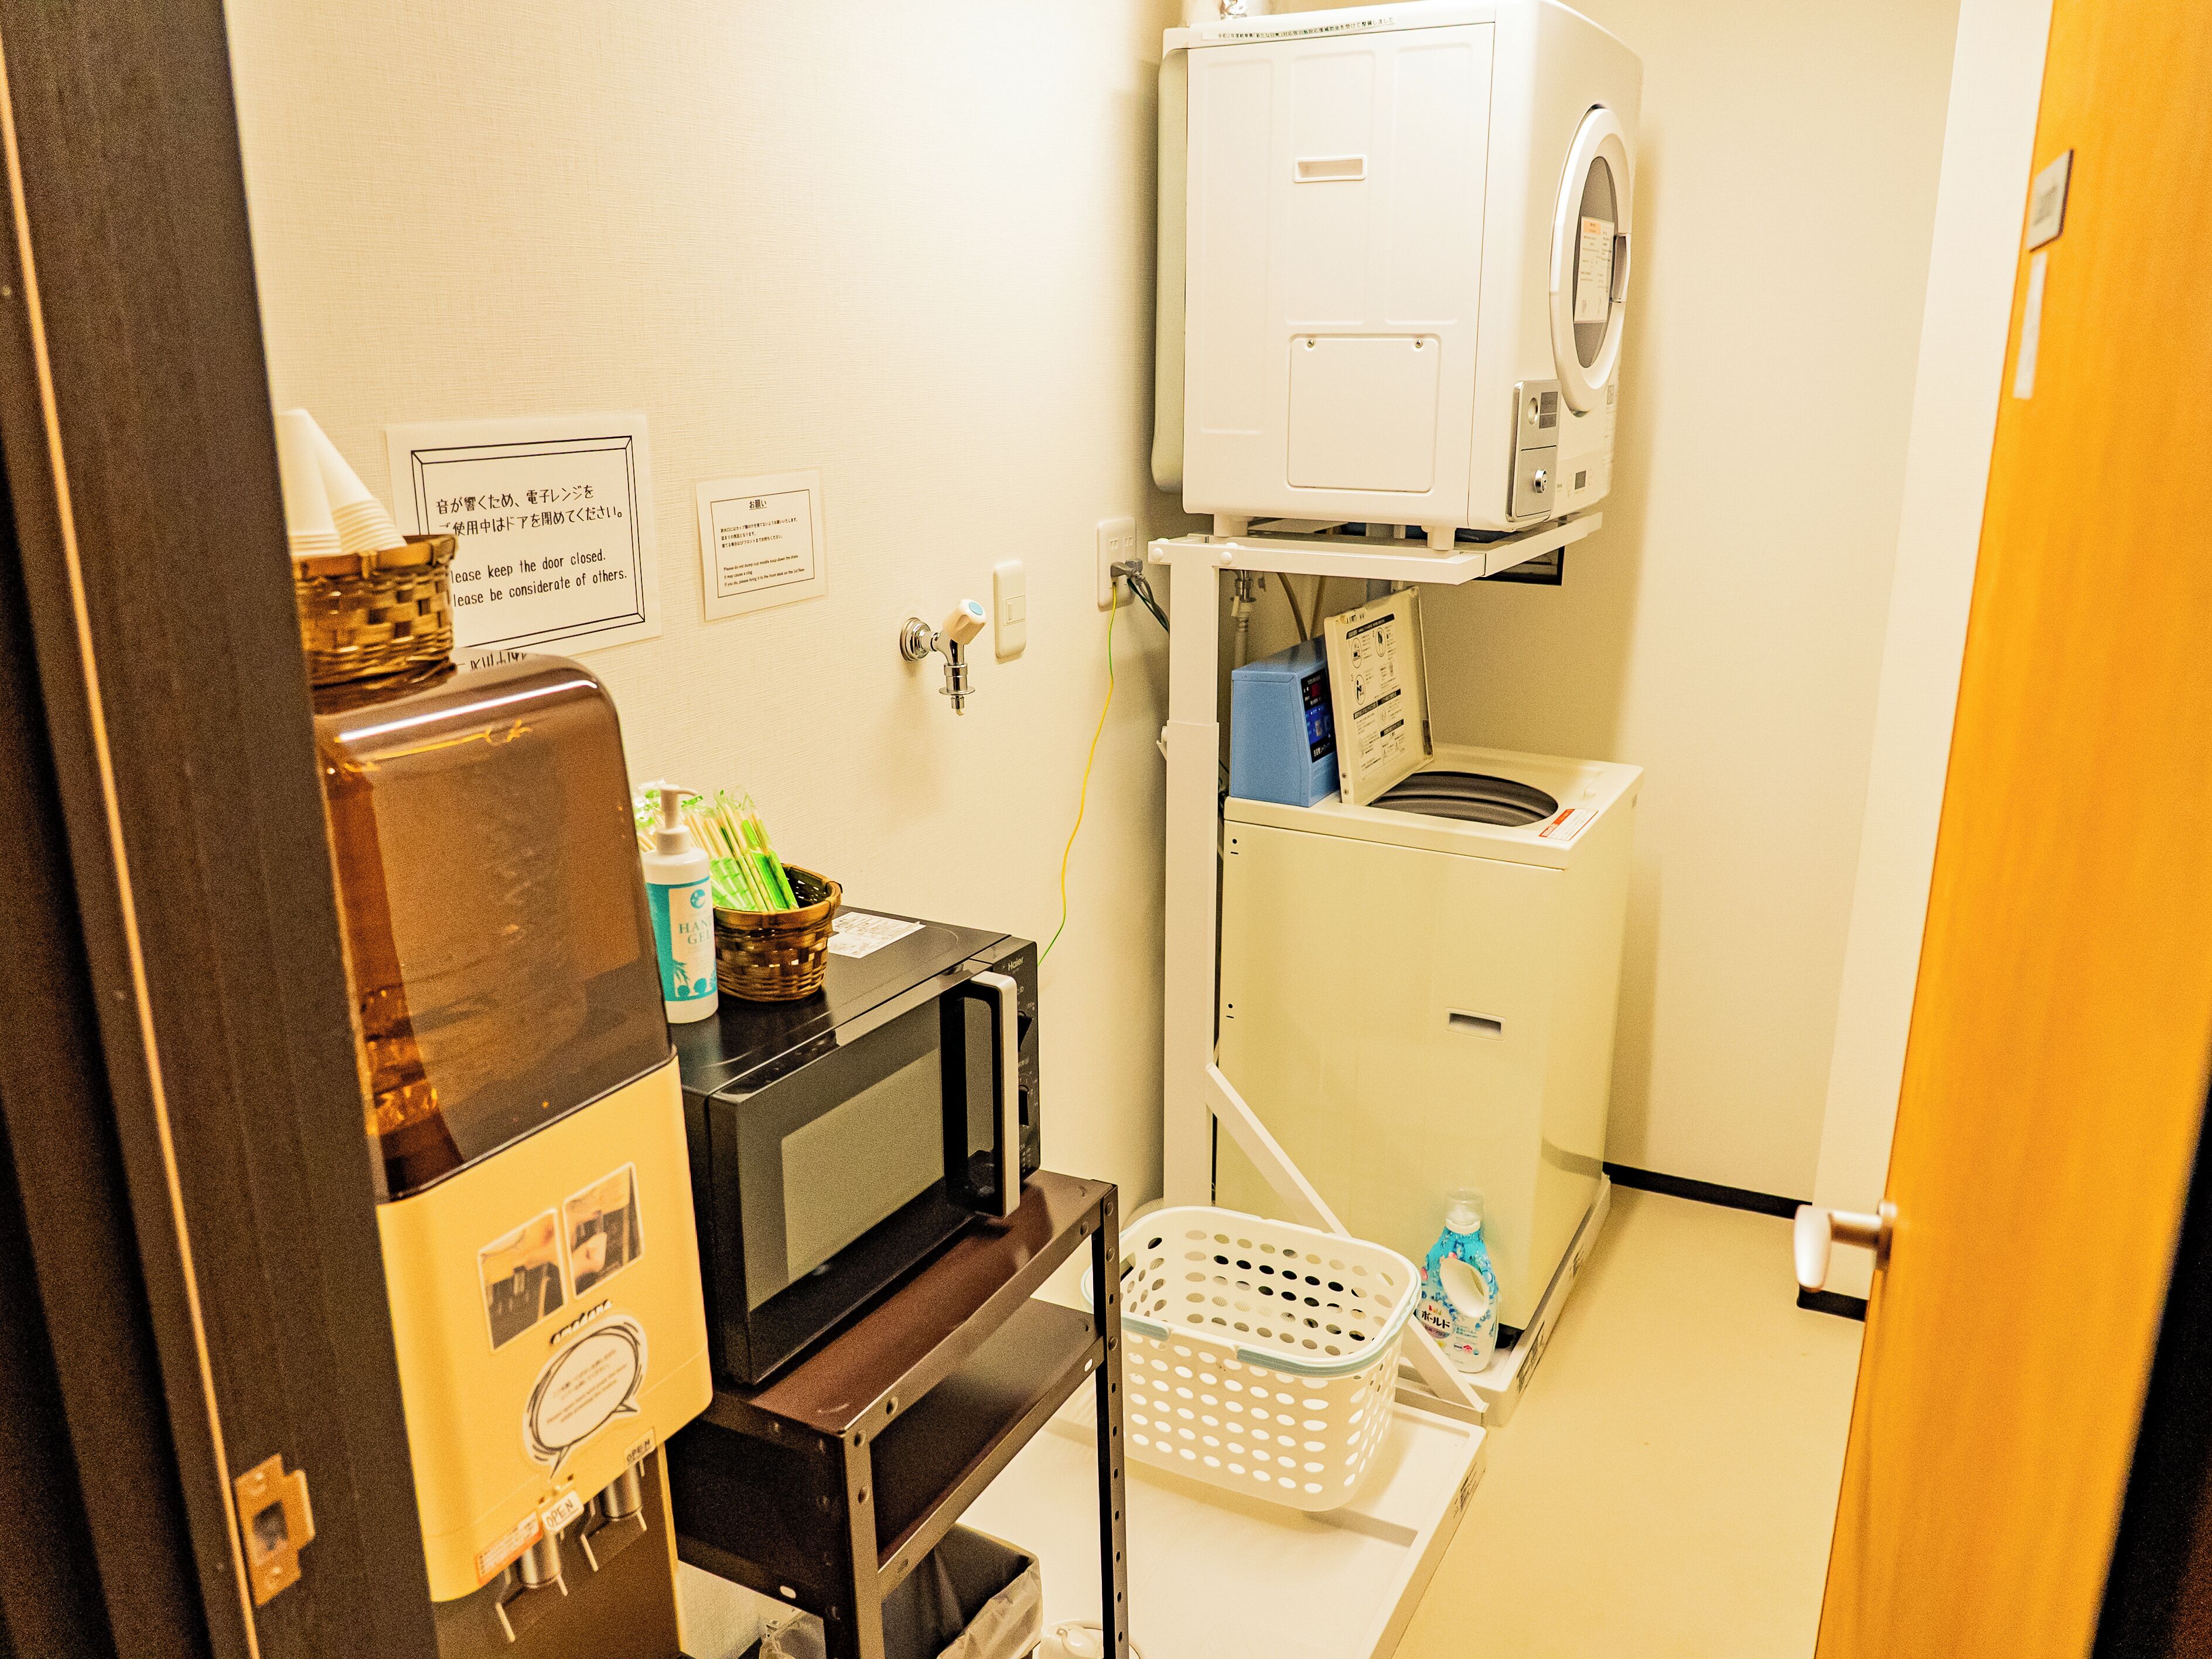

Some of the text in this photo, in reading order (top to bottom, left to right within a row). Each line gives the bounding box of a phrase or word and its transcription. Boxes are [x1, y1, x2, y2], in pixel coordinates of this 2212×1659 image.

[436, 484, 594, 514] 音が響くため、電子レンジを
[749, 499, 767, 508] お願い
[450, 548, 606, 584] lease keep the door closed.
[453, 569, 627, 607] lease be considerate of others.
[687, 930, 711, 944] GEL
[1008, 957, 1023, 971] Haier
[1422, 1310, 1450, 1329] ボールド
[626, 1438, 651, 1462] OPEN
[547, 1498, 574, 1527] OPEN
